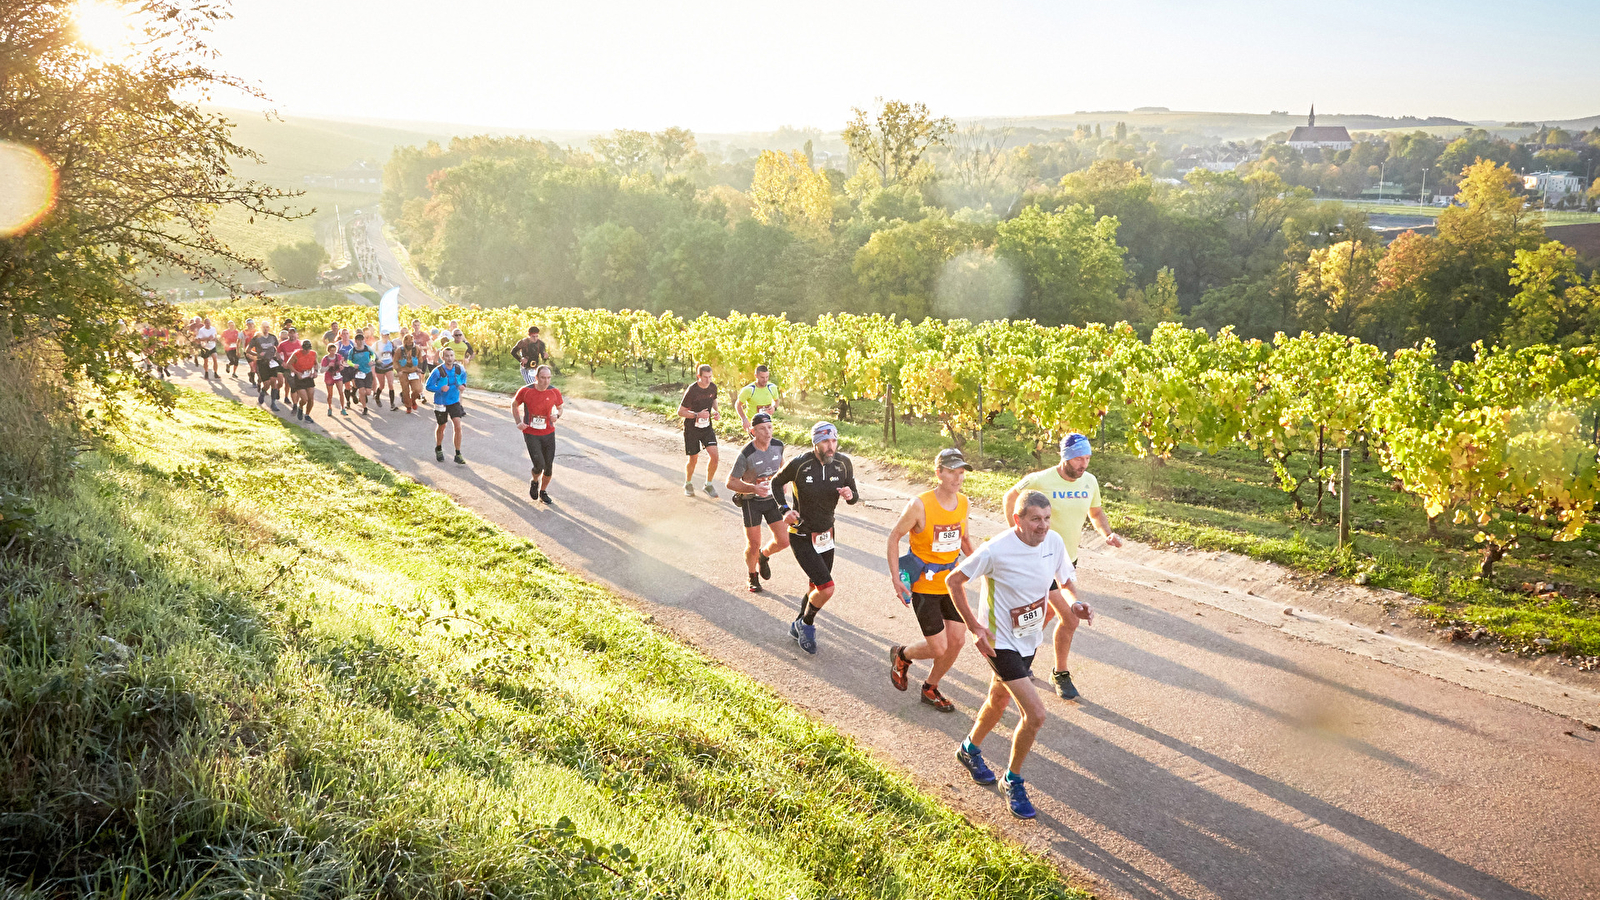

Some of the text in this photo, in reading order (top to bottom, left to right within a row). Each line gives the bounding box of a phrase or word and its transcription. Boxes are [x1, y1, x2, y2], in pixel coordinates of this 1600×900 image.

[1053, 491, 1088, 499] IVECO
[943, 531, 956, 539] 582
[1023, 610, 1038, 621] 581
